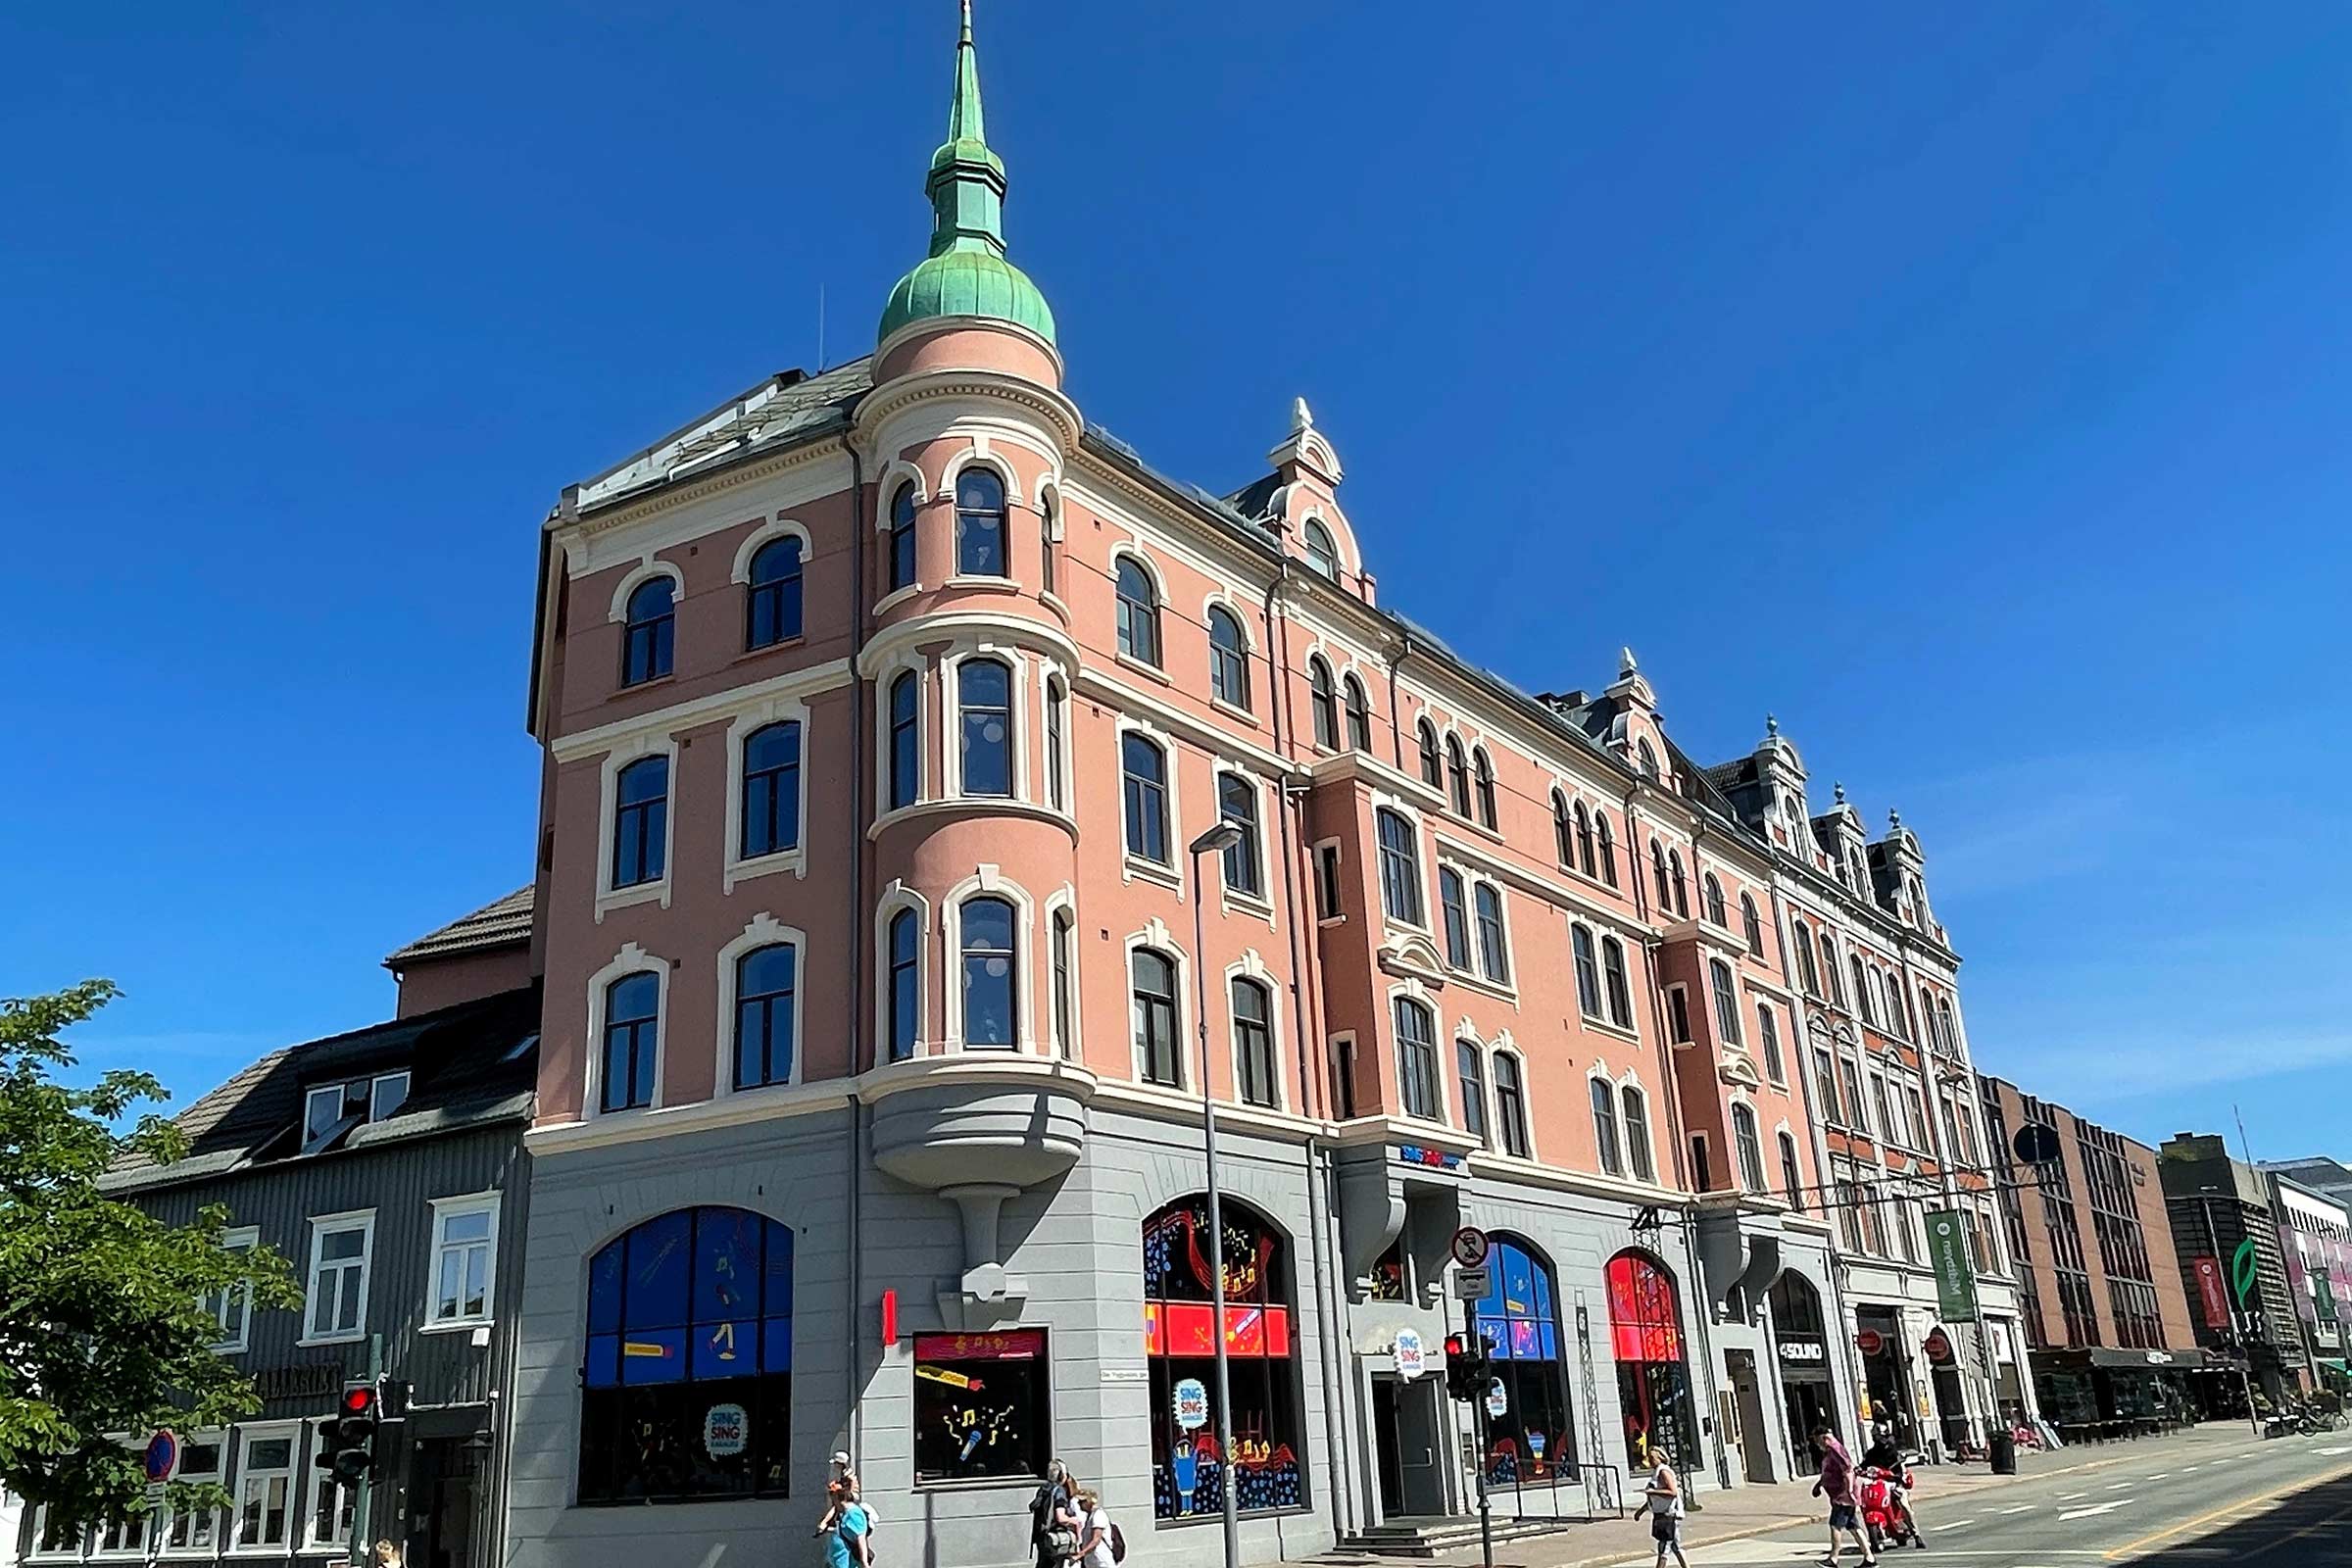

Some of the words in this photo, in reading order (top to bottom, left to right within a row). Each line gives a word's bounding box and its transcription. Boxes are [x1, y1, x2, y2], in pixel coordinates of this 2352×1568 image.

[1399, 1336, 1419, 1349] SING
[1400, 1349, 1421, 1362] SING
[1779, 1343, 1823, 1360] 4SOUND
[1180, 1388, 1201, 1400] SING
[1180, 1400, 1202, 1413] SING
[710, 1411, 741, 1426] SING
[710, 1426, 741, 1440] SING
